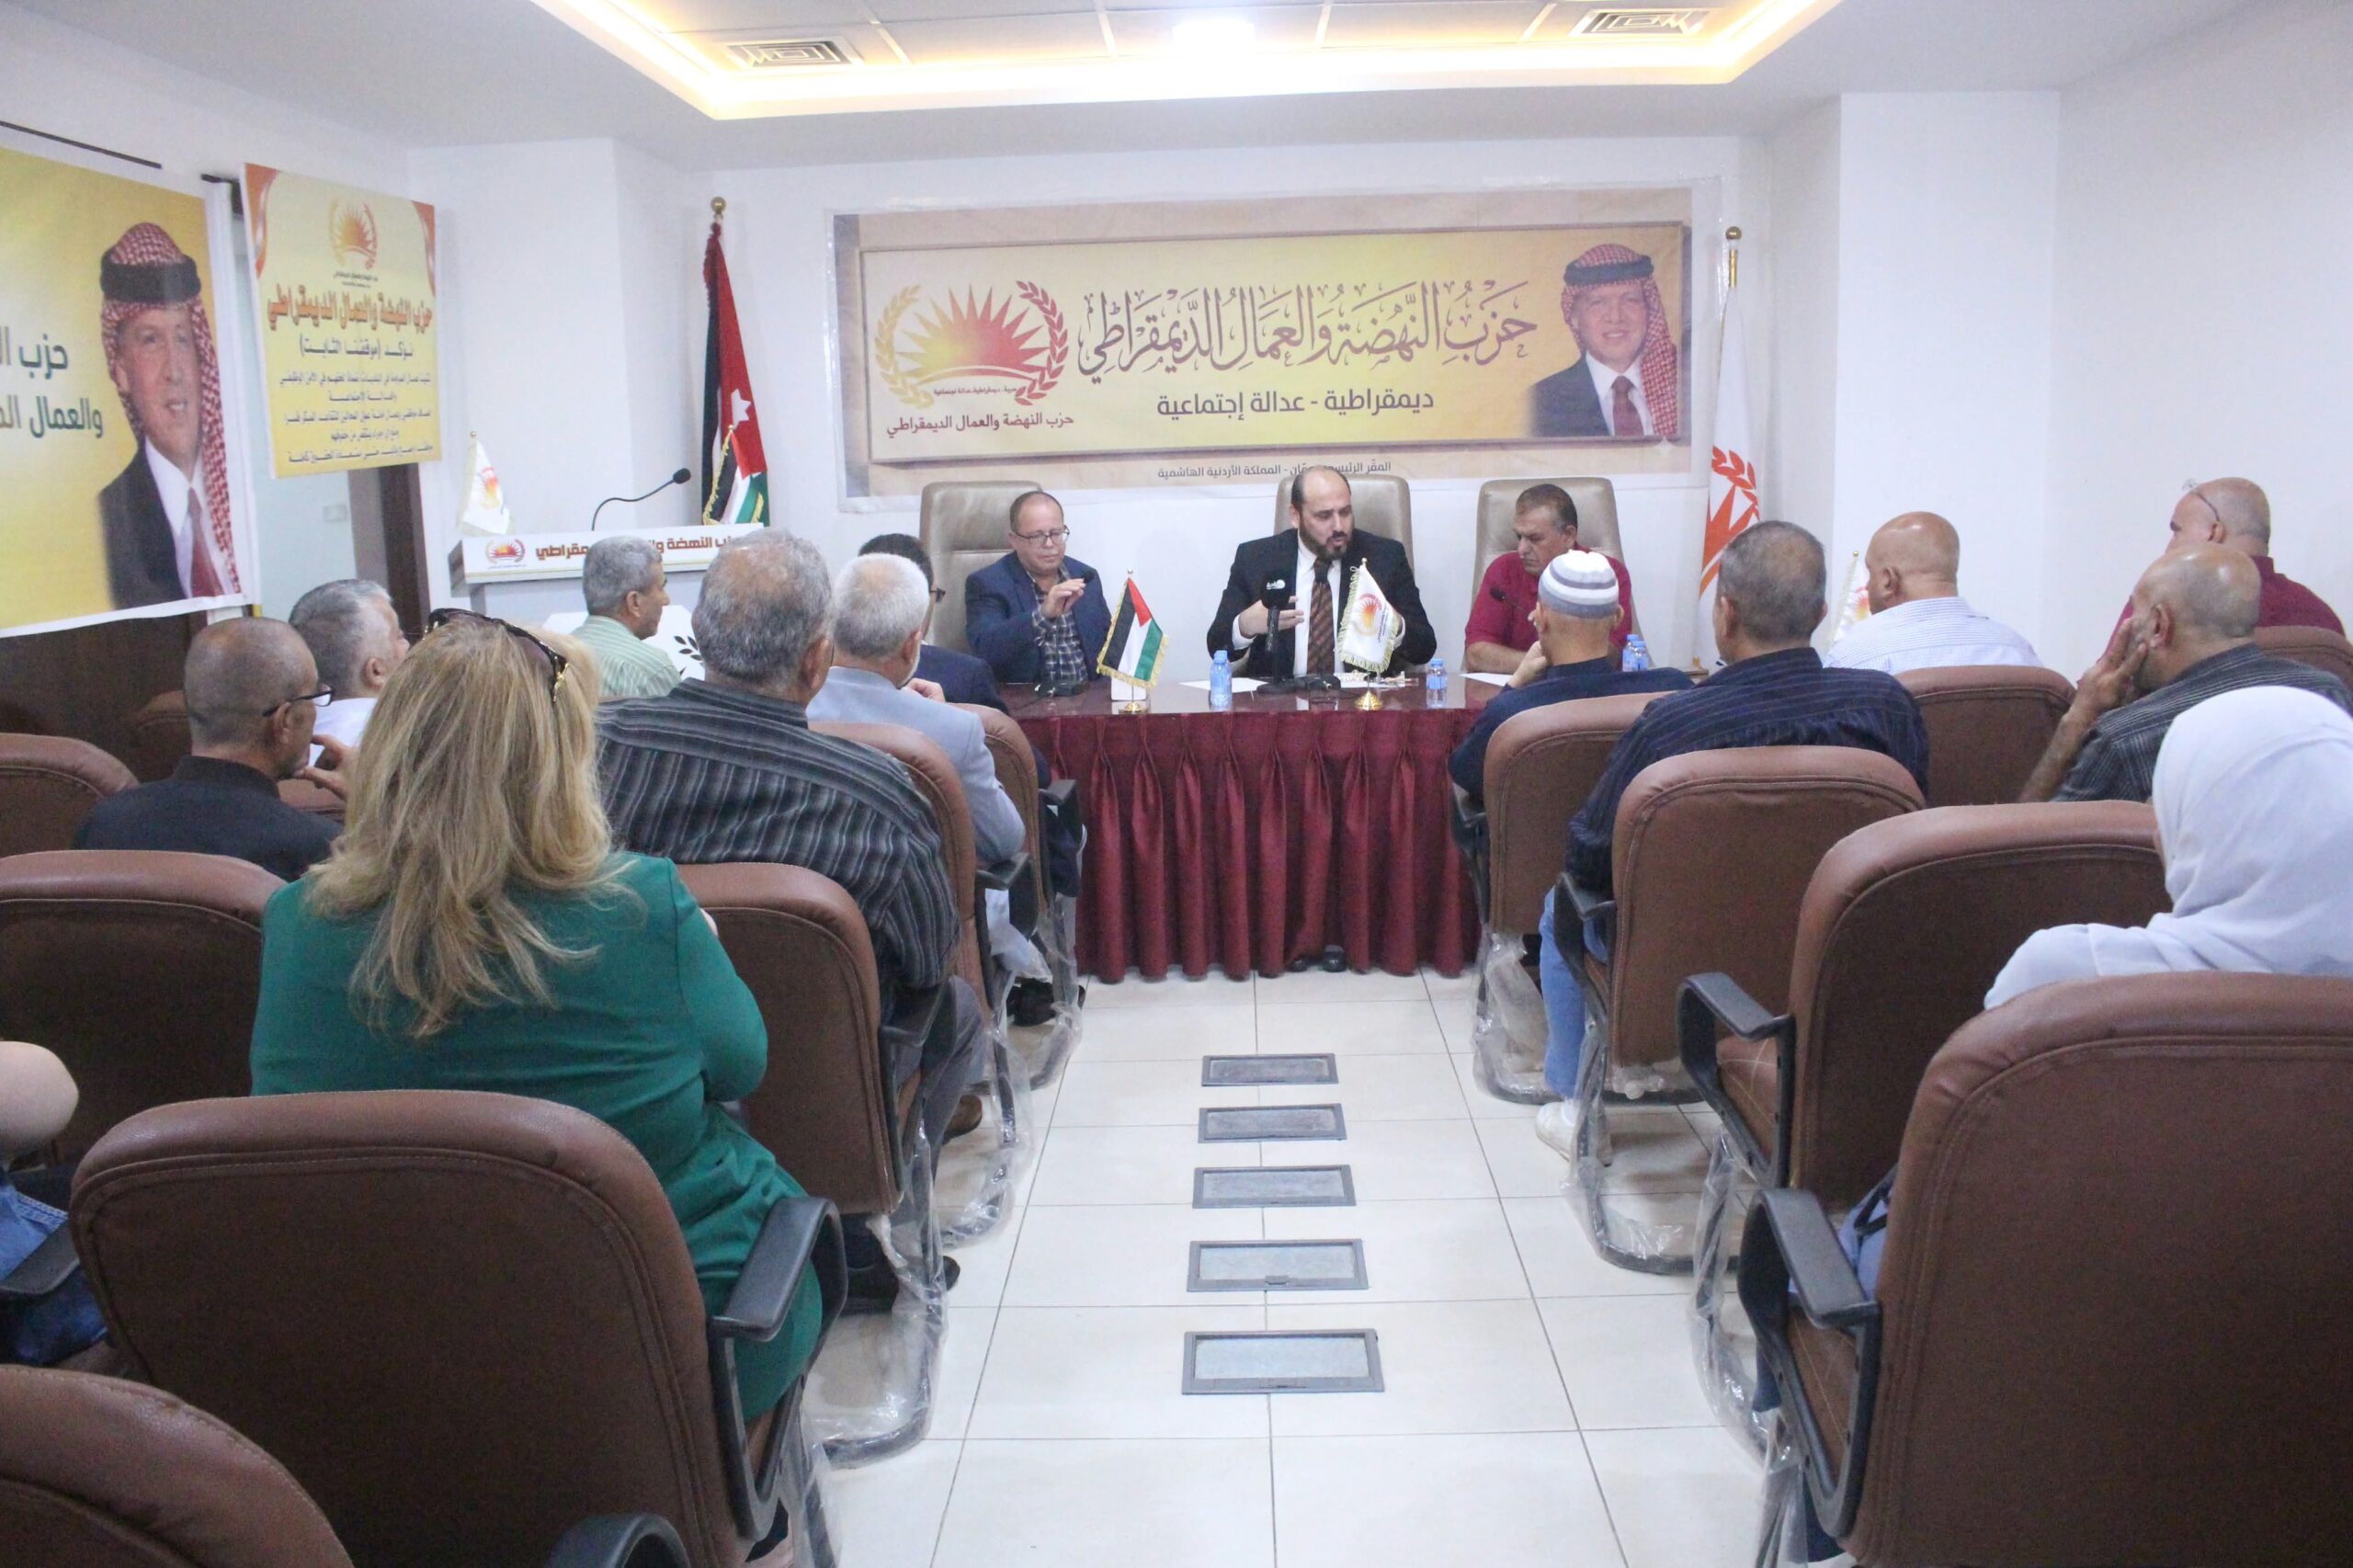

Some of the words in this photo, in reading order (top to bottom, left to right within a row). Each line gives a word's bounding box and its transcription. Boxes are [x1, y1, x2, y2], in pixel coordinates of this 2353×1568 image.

[18, 333, 68, 380] حزب
[1156, 392, 1245, 421] إجتماعية
[1250, 391, 1305, 413] عدالة
[1324, 387, 1434, 416] ديمقراطية
[28, 394, 103, 438] والعمال
[956, 415, 1000, 431] والعمال
[1003, 412, 1042, 429] النهضة
[1046, 414, 1074, 428] حزب
[887, 415, 952, 438] الديمقراطي
[1157, 466, 1204, 478] الهاشمية
[1207, 464, 1241, 478] الأردنية
[1244, 465, 1281, 476] المملكة
[1333, 461, 1363, 474] الرئيس
[536, 542, 589, 561] مقراطي
[666, 536, 713, 551] النهضة
